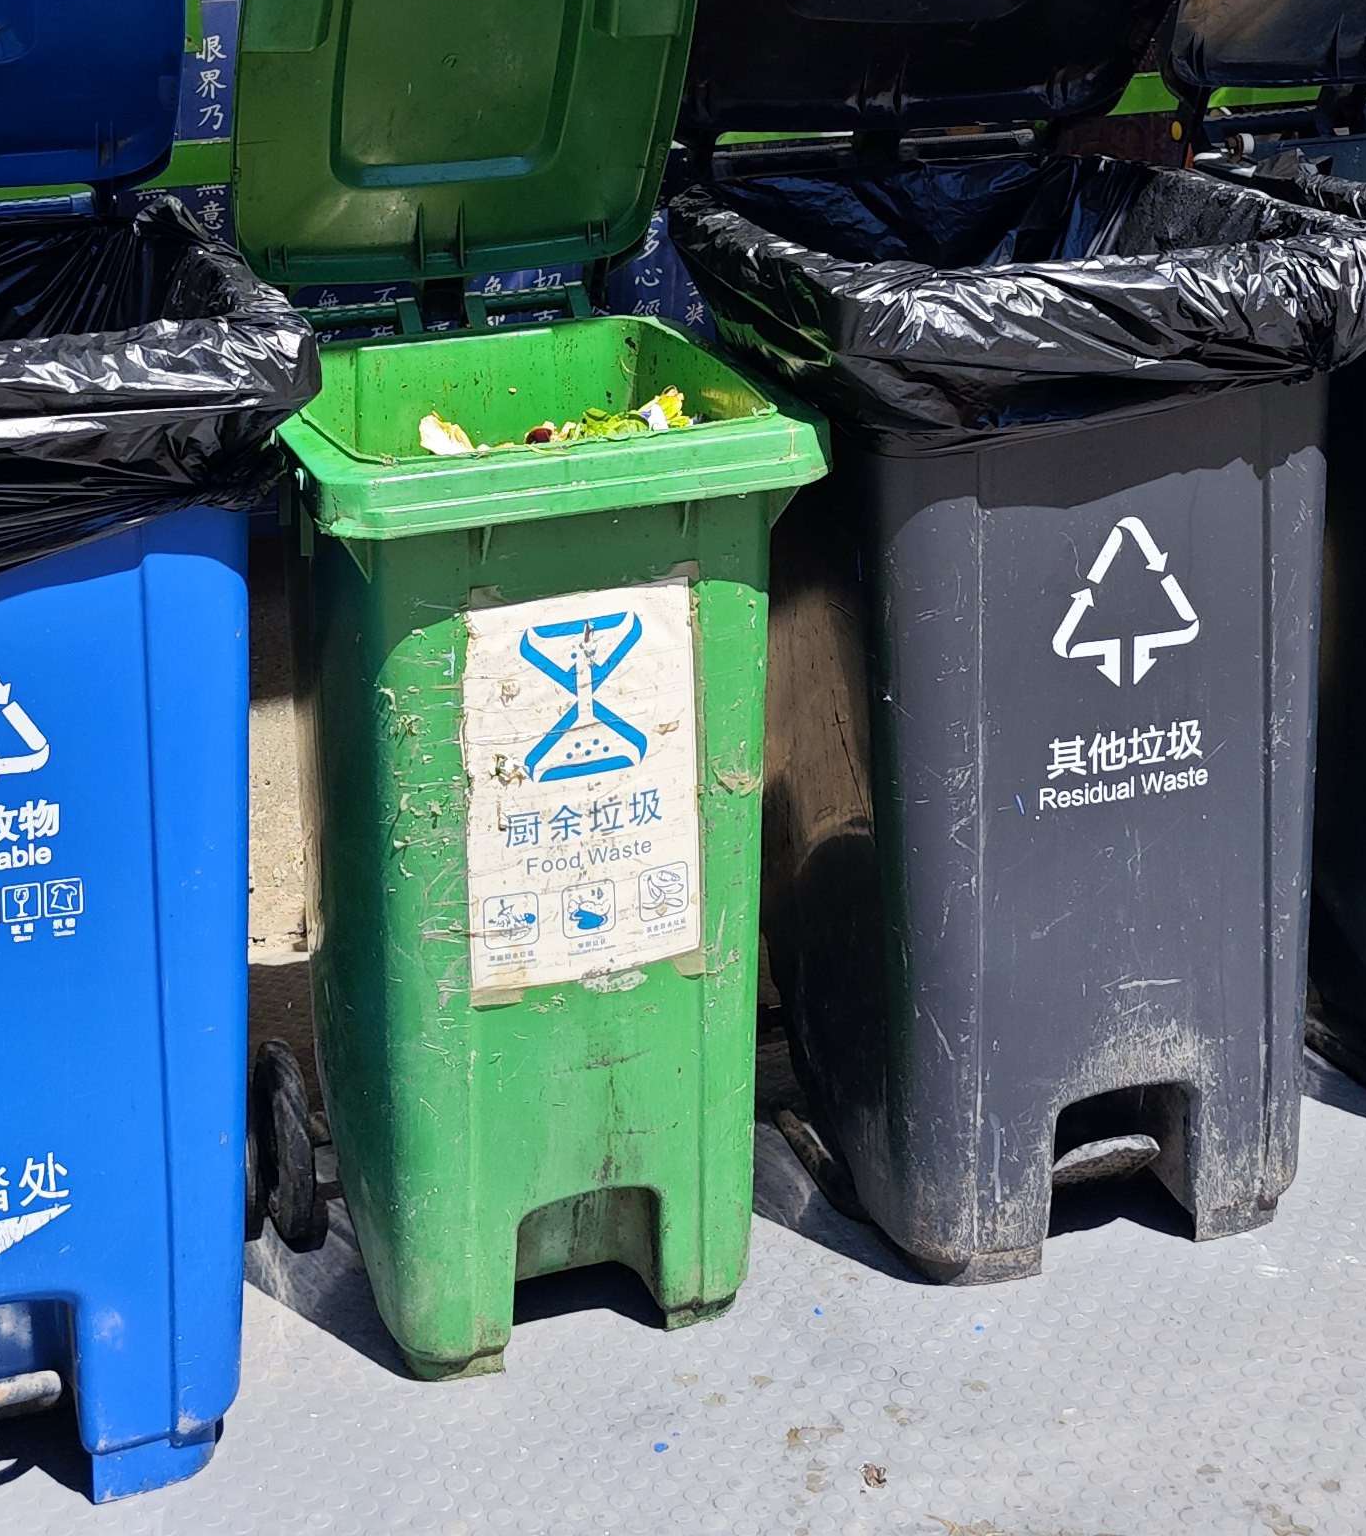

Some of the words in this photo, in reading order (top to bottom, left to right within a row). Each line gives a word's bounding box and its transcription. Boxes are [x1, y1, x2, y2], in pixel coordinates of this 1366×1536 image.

[1047, 719, 1204, 780] 其他垃圾
[1039, 775, 1135, 810] Residual
[1141, 766, 1209, 795] Waste
[504, 788, 662, 849] 厨余垃圾
[526, 850, 581, 876] Food
[588, 838, 653, 867] Waste
